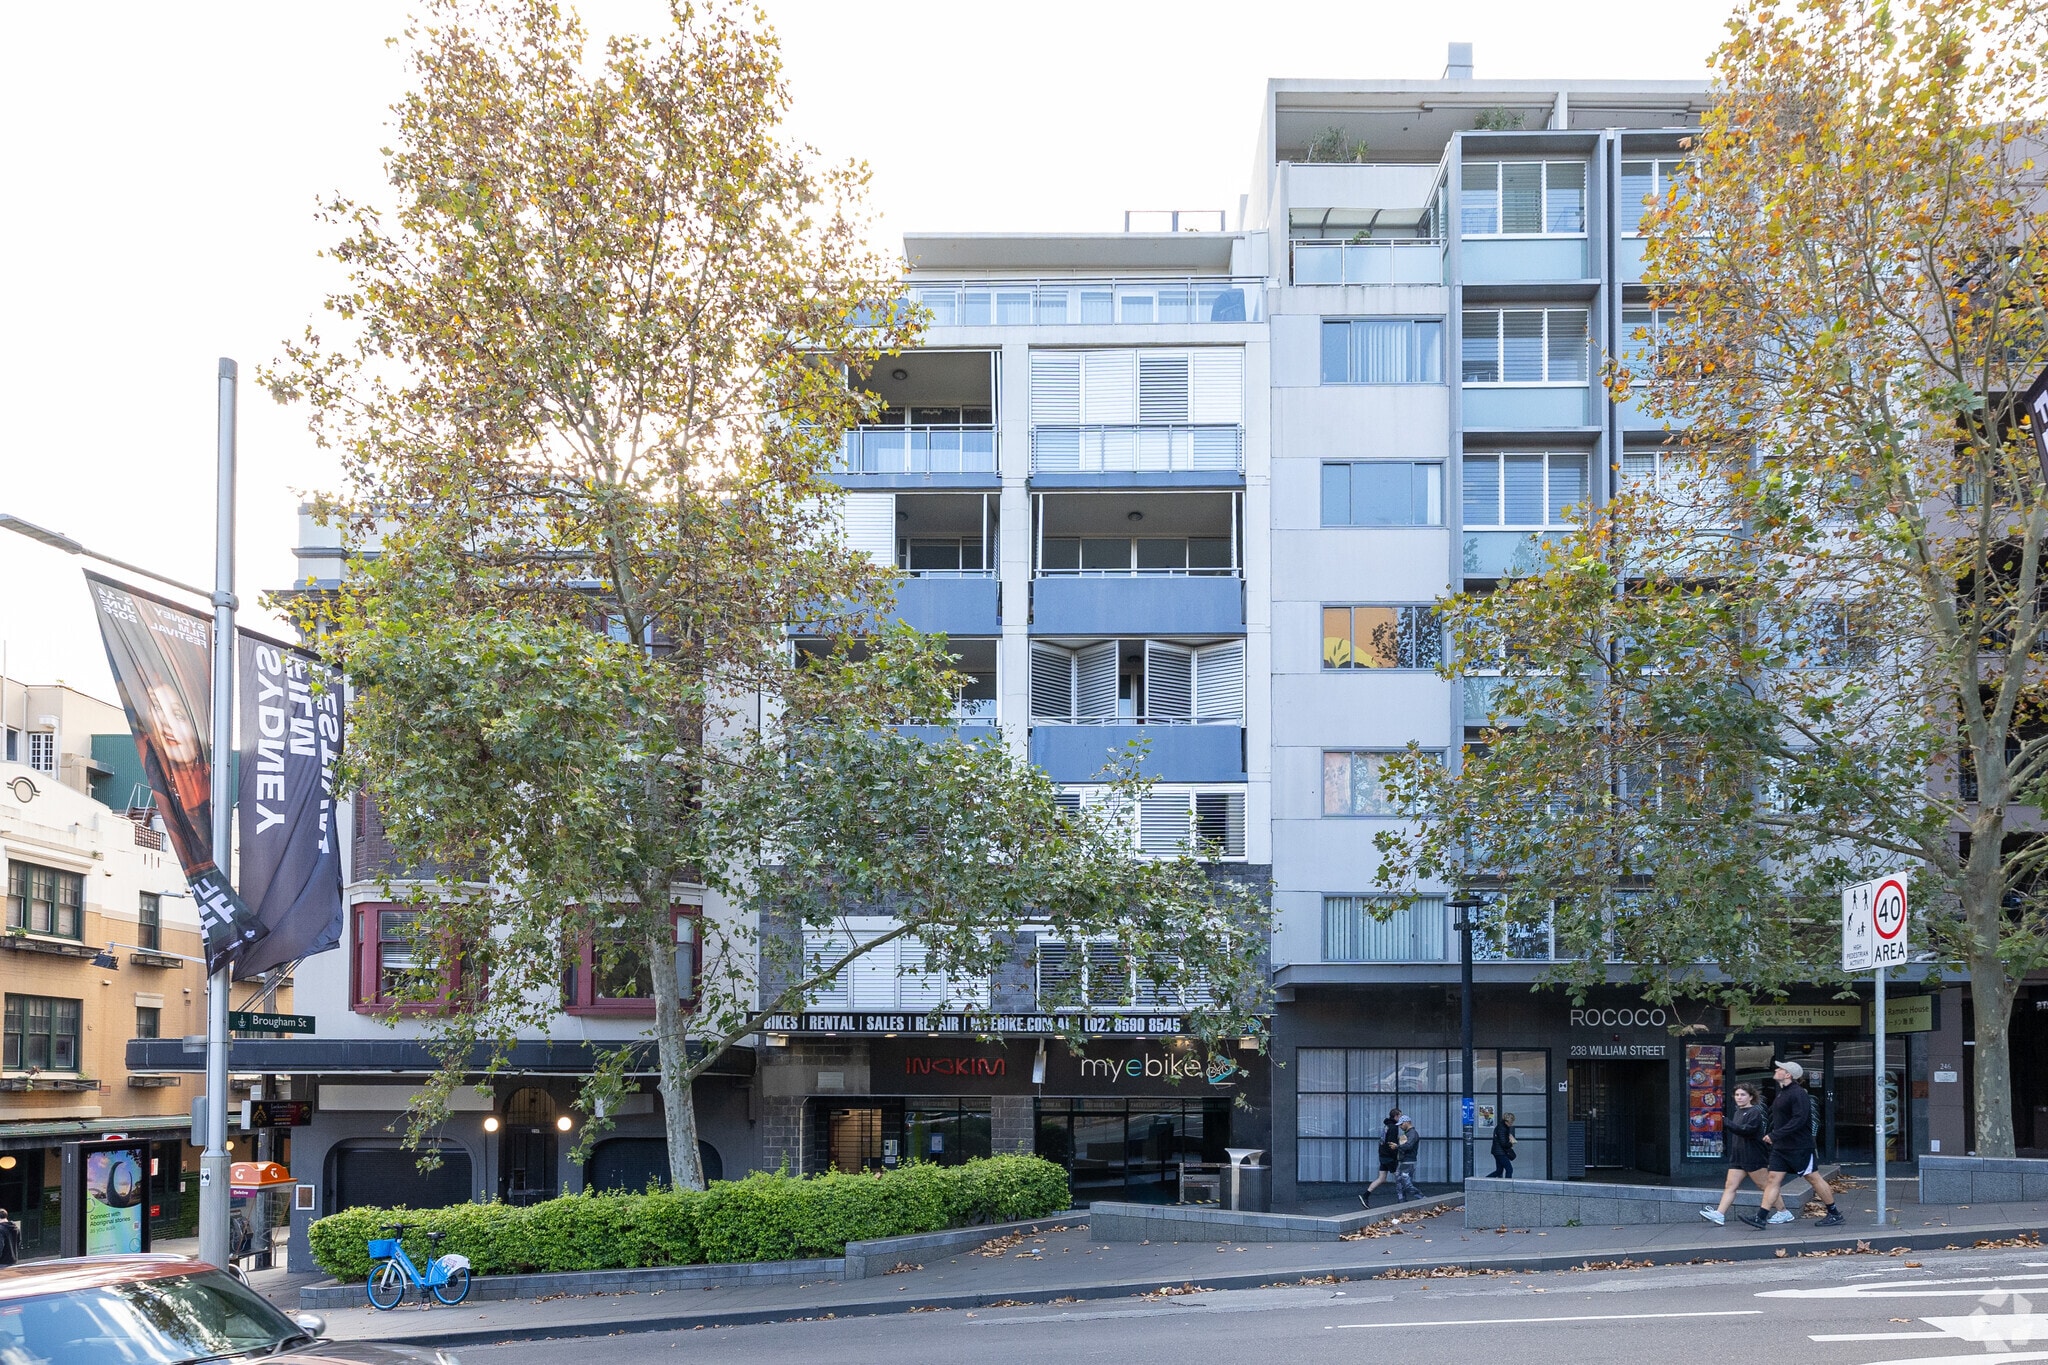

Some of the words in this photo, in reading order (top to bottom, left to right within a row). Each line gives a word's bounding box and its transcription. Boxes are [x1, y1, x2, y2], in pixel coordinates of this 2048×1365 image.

[1878, 896, 1900, 922] 40
[1846, 951, 1869, 960] PEDESTRIAN
[1875, 942, 1905, 962] AREA
[1813, 1007, 1846, 1017] House
[1910, 1005, 1930, 1014] House
[252, 1015, 296, 1029] Brougham
[298, 1017, 307, 1028] St
[809, 1015, 855, 1031] RENTAL
[866, 1015, 904, 1031] SALES
[1114, 1017, 1143, 1032] 8590
[1148, 1018, 1181, 1032] 8545
[1570, 1008, 1666, 1027] ROCOCO
[1570, 1045, 1587, 1056] 238
[1589, 1045, 1627, 1056] WILLIAM
[1629, 1045, 1666, 1056] STREET
[1081, 1052, 1203, 1083] myebike
[89, 1218, 114, 1227] Aboriginal
